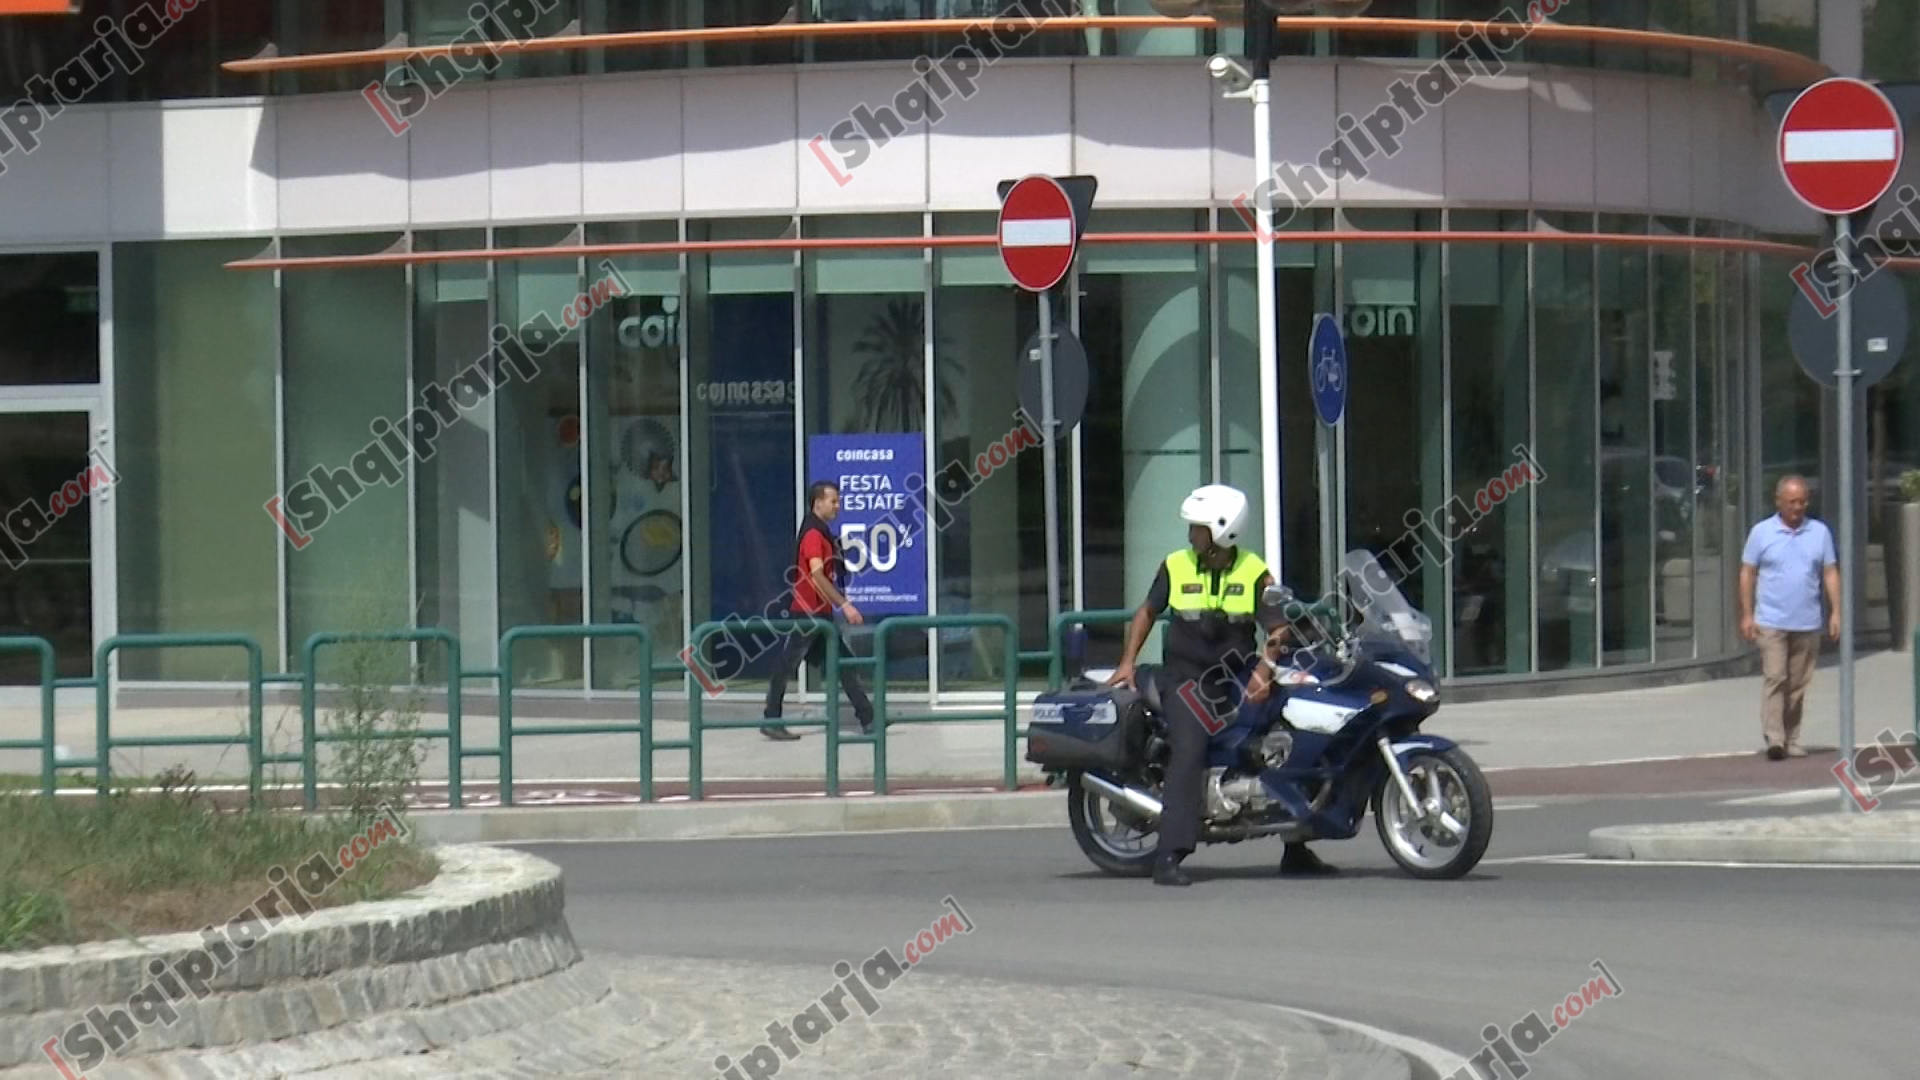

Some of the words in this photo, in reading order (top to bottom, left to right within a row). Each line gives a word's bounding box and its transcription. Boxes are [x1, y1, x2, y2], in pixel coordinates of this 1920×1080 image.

[618, 296, 681, 348] coi
[836, 449, 894, 461] coincasa
[840, 475, 892, 491] FESTA
